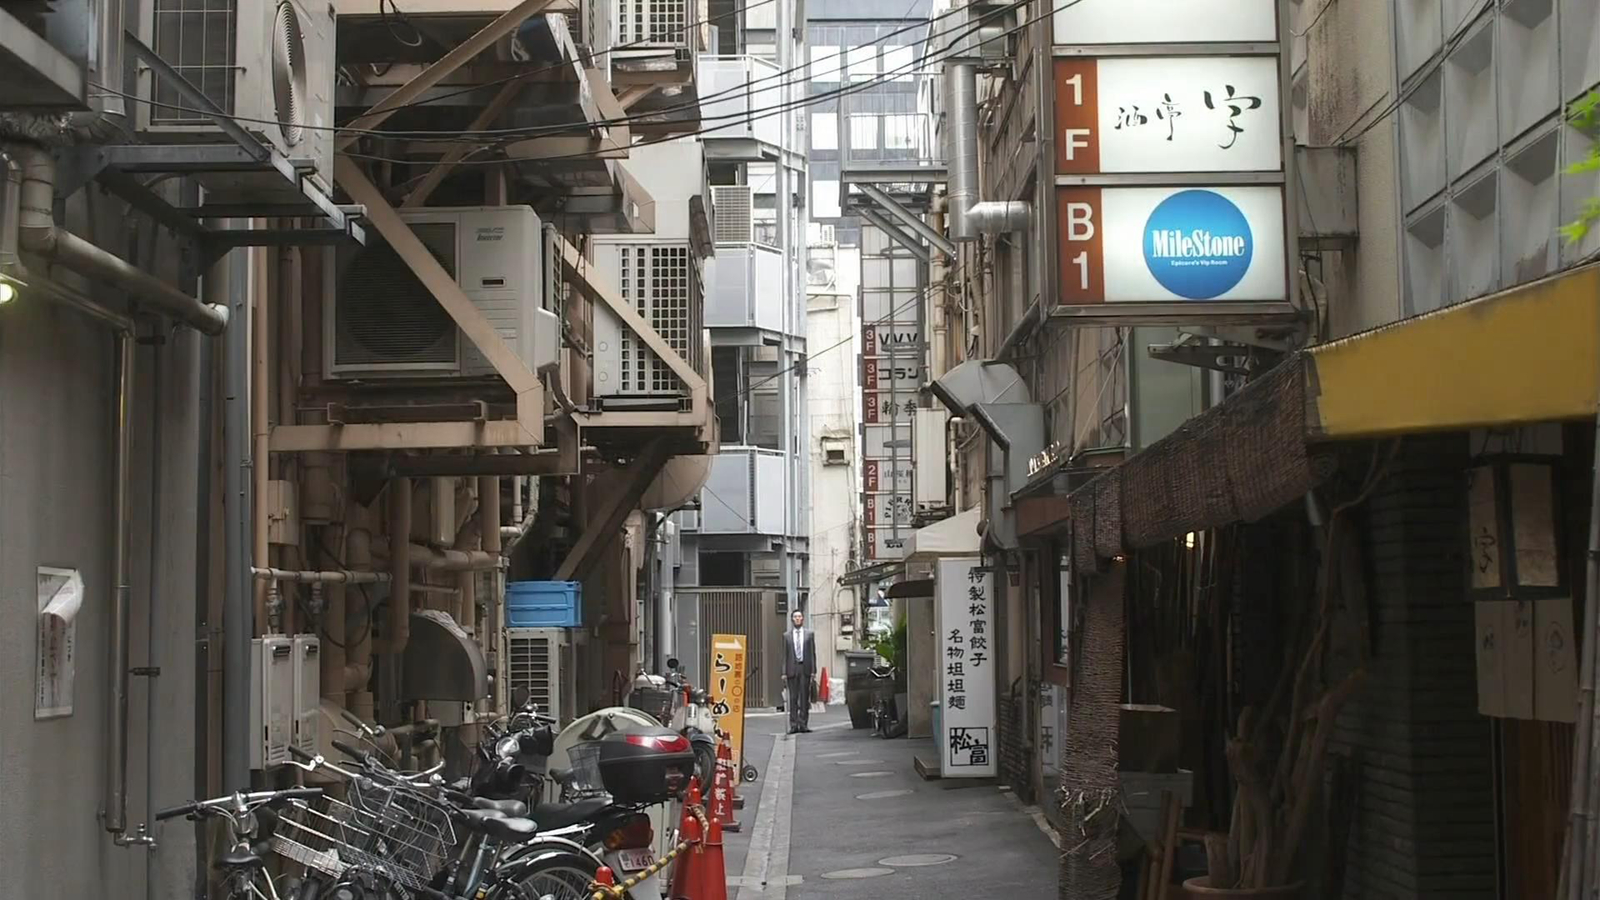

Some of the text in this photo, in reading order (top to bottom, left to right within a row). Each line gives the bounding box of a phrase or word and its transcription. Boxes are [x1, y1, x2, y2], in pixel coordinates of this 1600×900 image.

[1065, 74, 1090, 160] 1F
[1067, 203, 1094, 289] B1
[1152, 229, 1245, 258] MileStone
[866, 330, 874, 351] 3F
[867, 364, 875, 385] 3F
[868, 398, 876, 419] 3F
[868, 465, 876, 486] 2F
[868, 499, 874, 520] B1
[868, 533, 875, 554] B1
[950, 728, 988, 766] 松富
